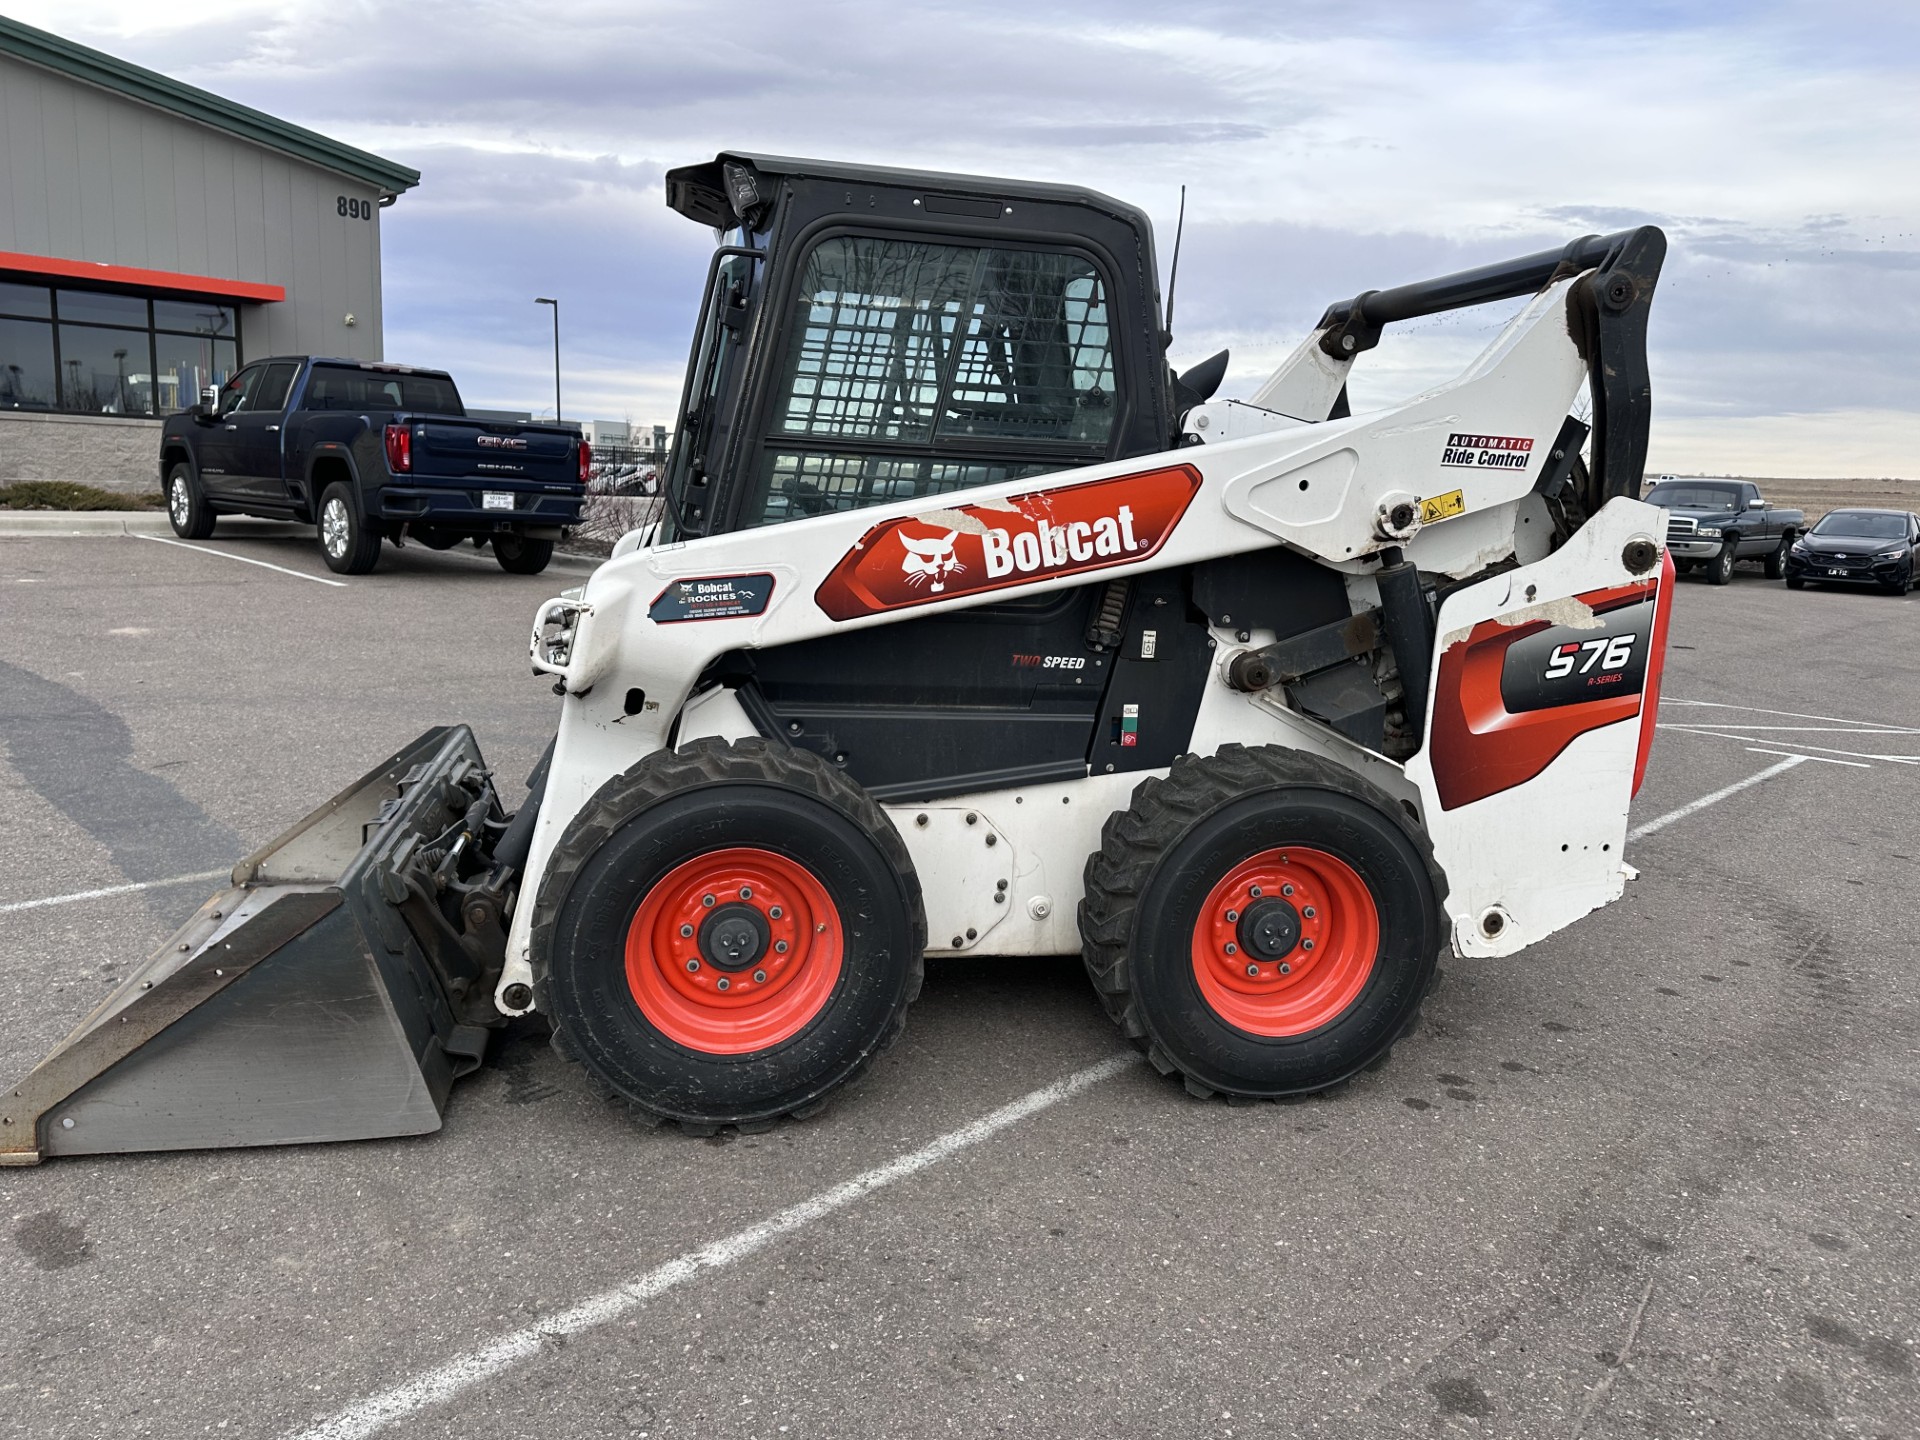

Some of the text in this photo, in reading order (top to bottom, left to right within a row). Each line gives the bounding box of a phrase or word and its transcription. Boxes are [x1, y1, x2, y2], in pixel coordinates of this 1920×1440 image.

[337, 196, 371, 221] 890
[477, 436, 527, 450] GMC
[1450, 435, 1531, 450] AUTOMATIC
[1441, 448, 1530, 468] Ride Control
[981, 505, 1138, 579] Bobcat
[697, 582, 733, 594] Bobcat
[687, 592, 737, 604] ROCKIES
[1012, 655, 1086, 670] TWO SPEED
[1544, 633, 1637, 680] S76
[1587, 673, 1623, 686] R-SERIES
